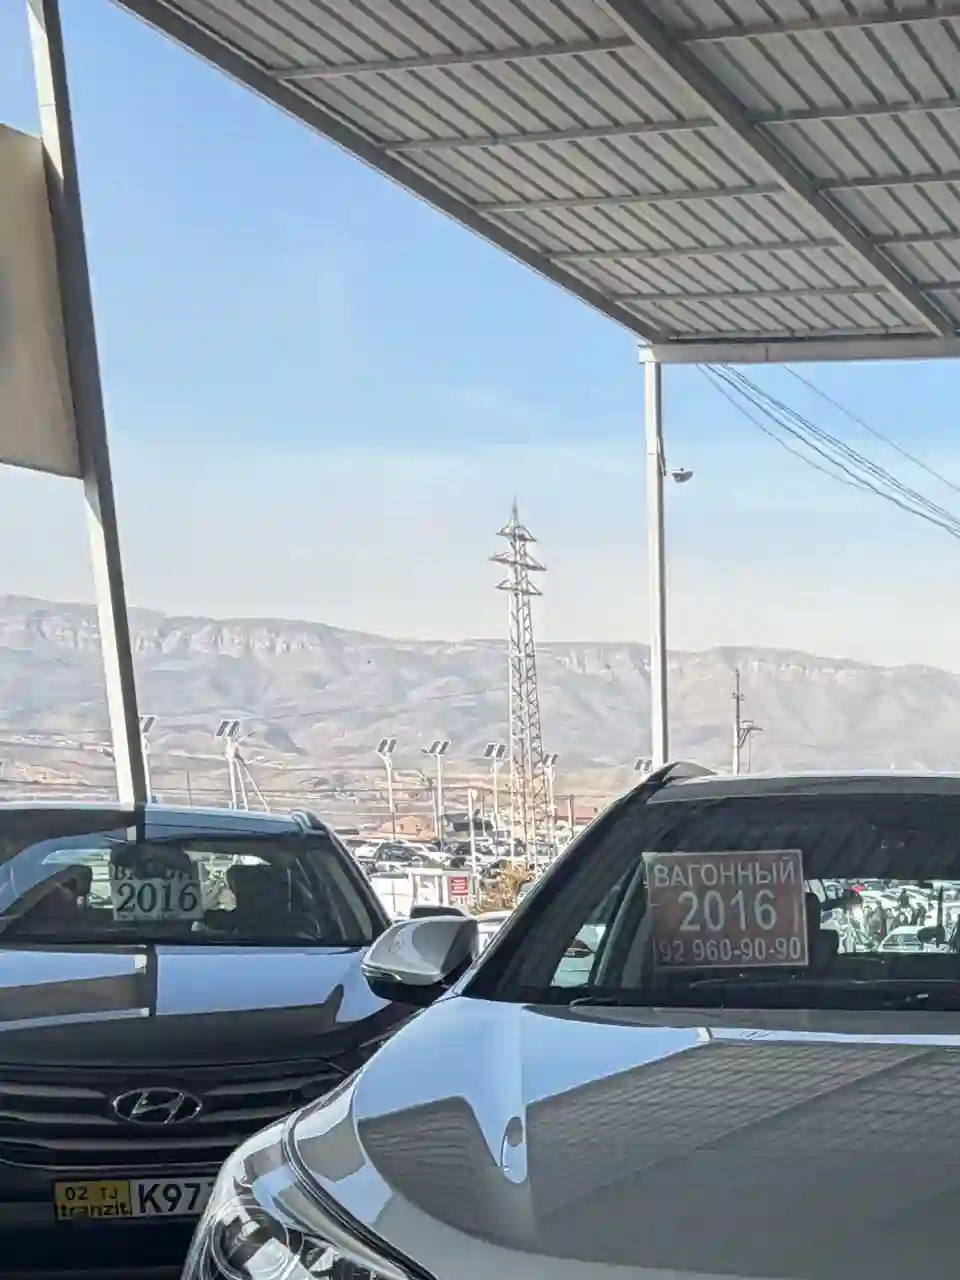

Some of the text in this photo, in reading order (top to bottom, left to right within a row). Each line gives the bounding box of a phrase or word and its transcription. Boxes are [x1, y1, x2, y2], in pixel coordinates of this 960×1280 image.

[653, 856, 795, 888] ВАГОННЫЙ
[116, 882, 198, 913] 2016
[677, 889, 778, 931] 2016
[692, 936, 801, 962] 960-90-90
[65, 1186, 118, 1201] 02 TJ
[138, 1182, 216, 1213] K97
